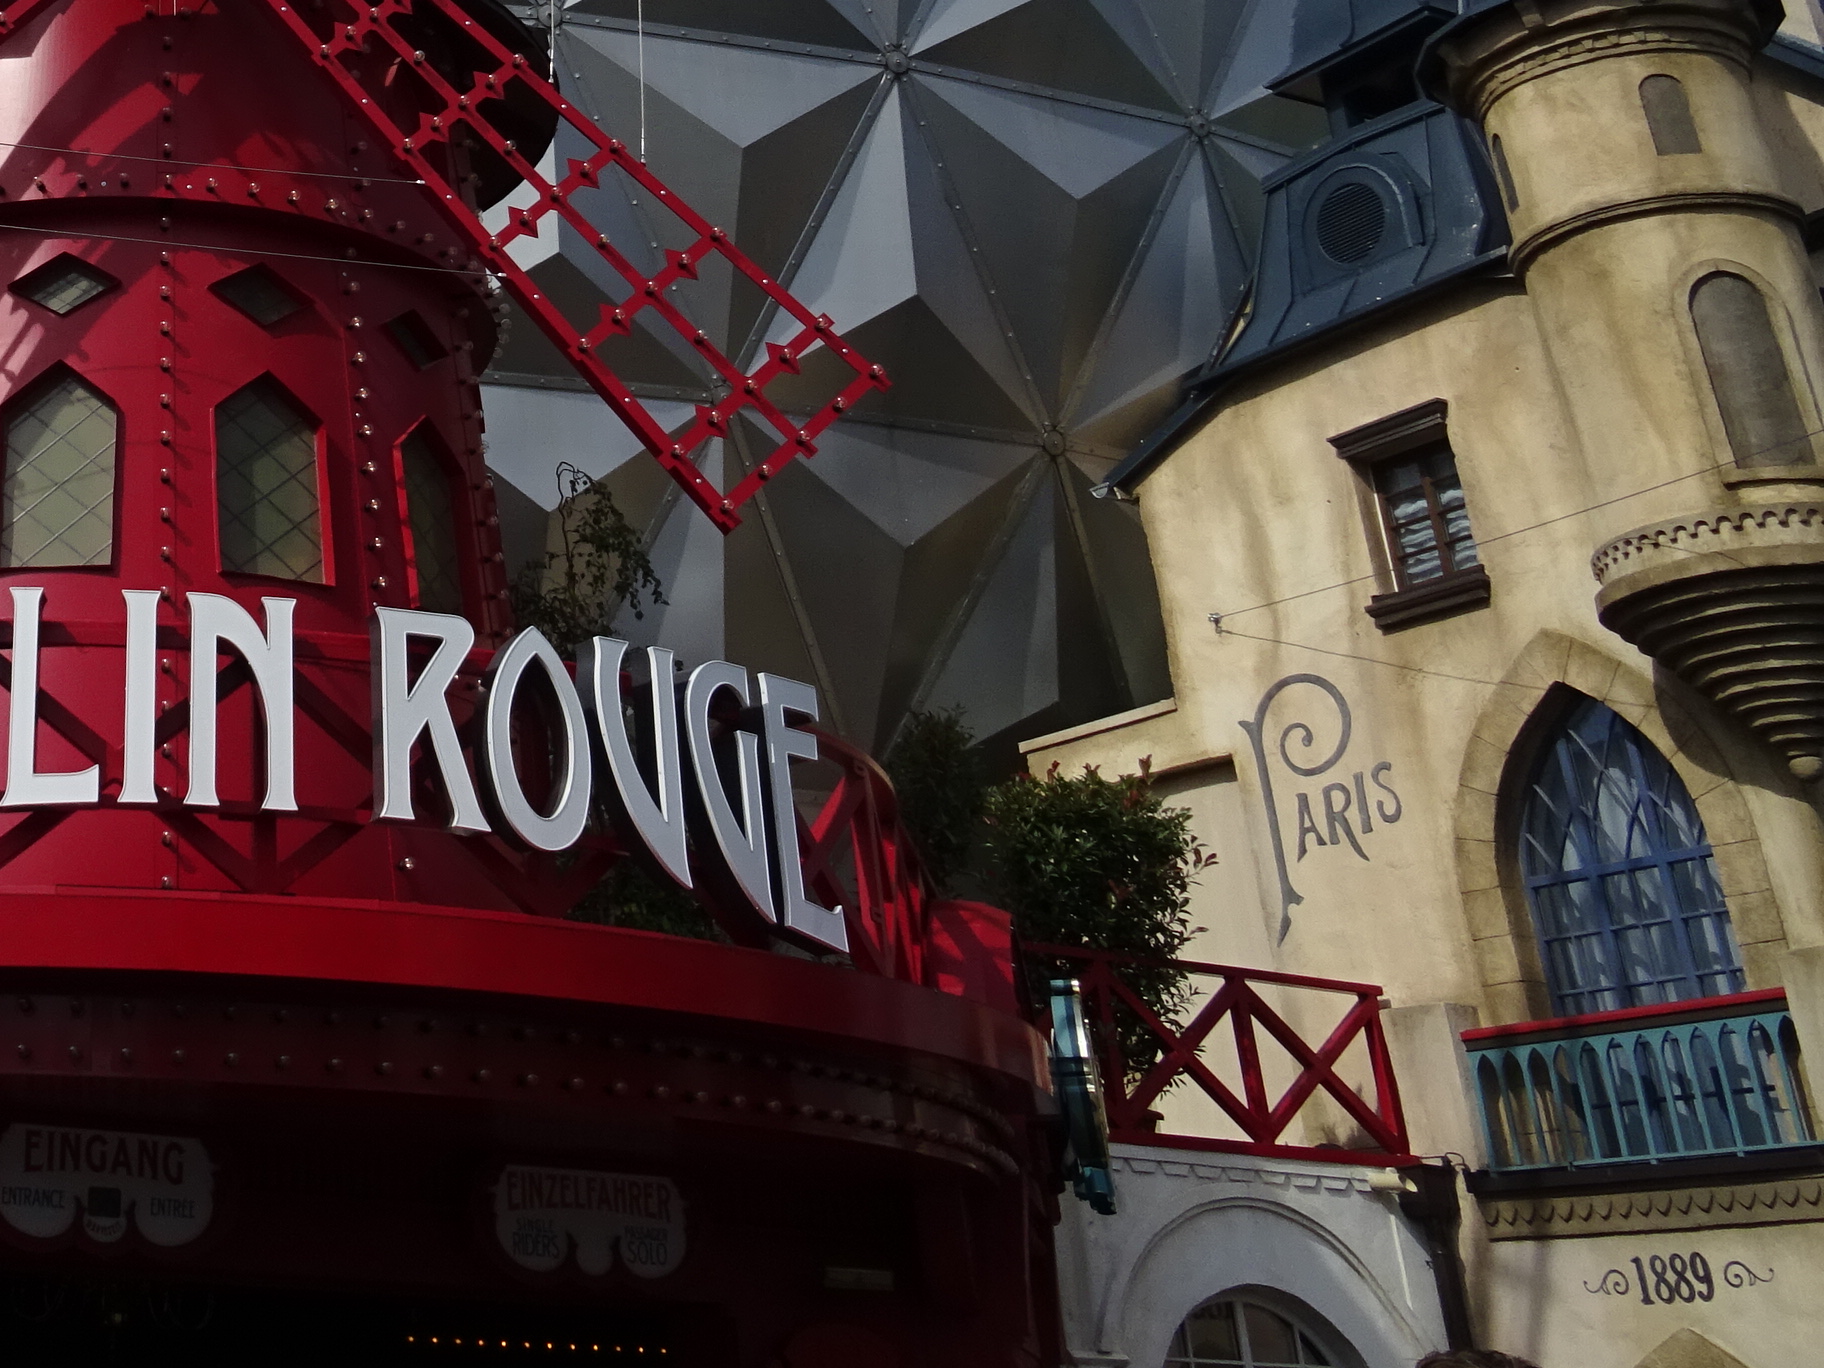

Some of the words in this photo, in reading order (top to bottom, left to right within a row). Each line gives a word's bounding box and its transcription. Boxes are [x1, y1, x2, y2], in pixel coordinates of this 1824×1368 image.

[372, 606, 850, 954] ROUGE
[1238, 672, 1403, 948] PARIS
[23, 1128, 185, 1186] EINGANG
[0, 1185, 65, 1210] ENTRANCE
[506, 1170, 672, 1223] EINZELFAHRER
[512, 1232, 561, 1258] RIDERS
[626, 1240, 668, 1266] SOLO
[1629, 1251, 1716, 1307] 1889
